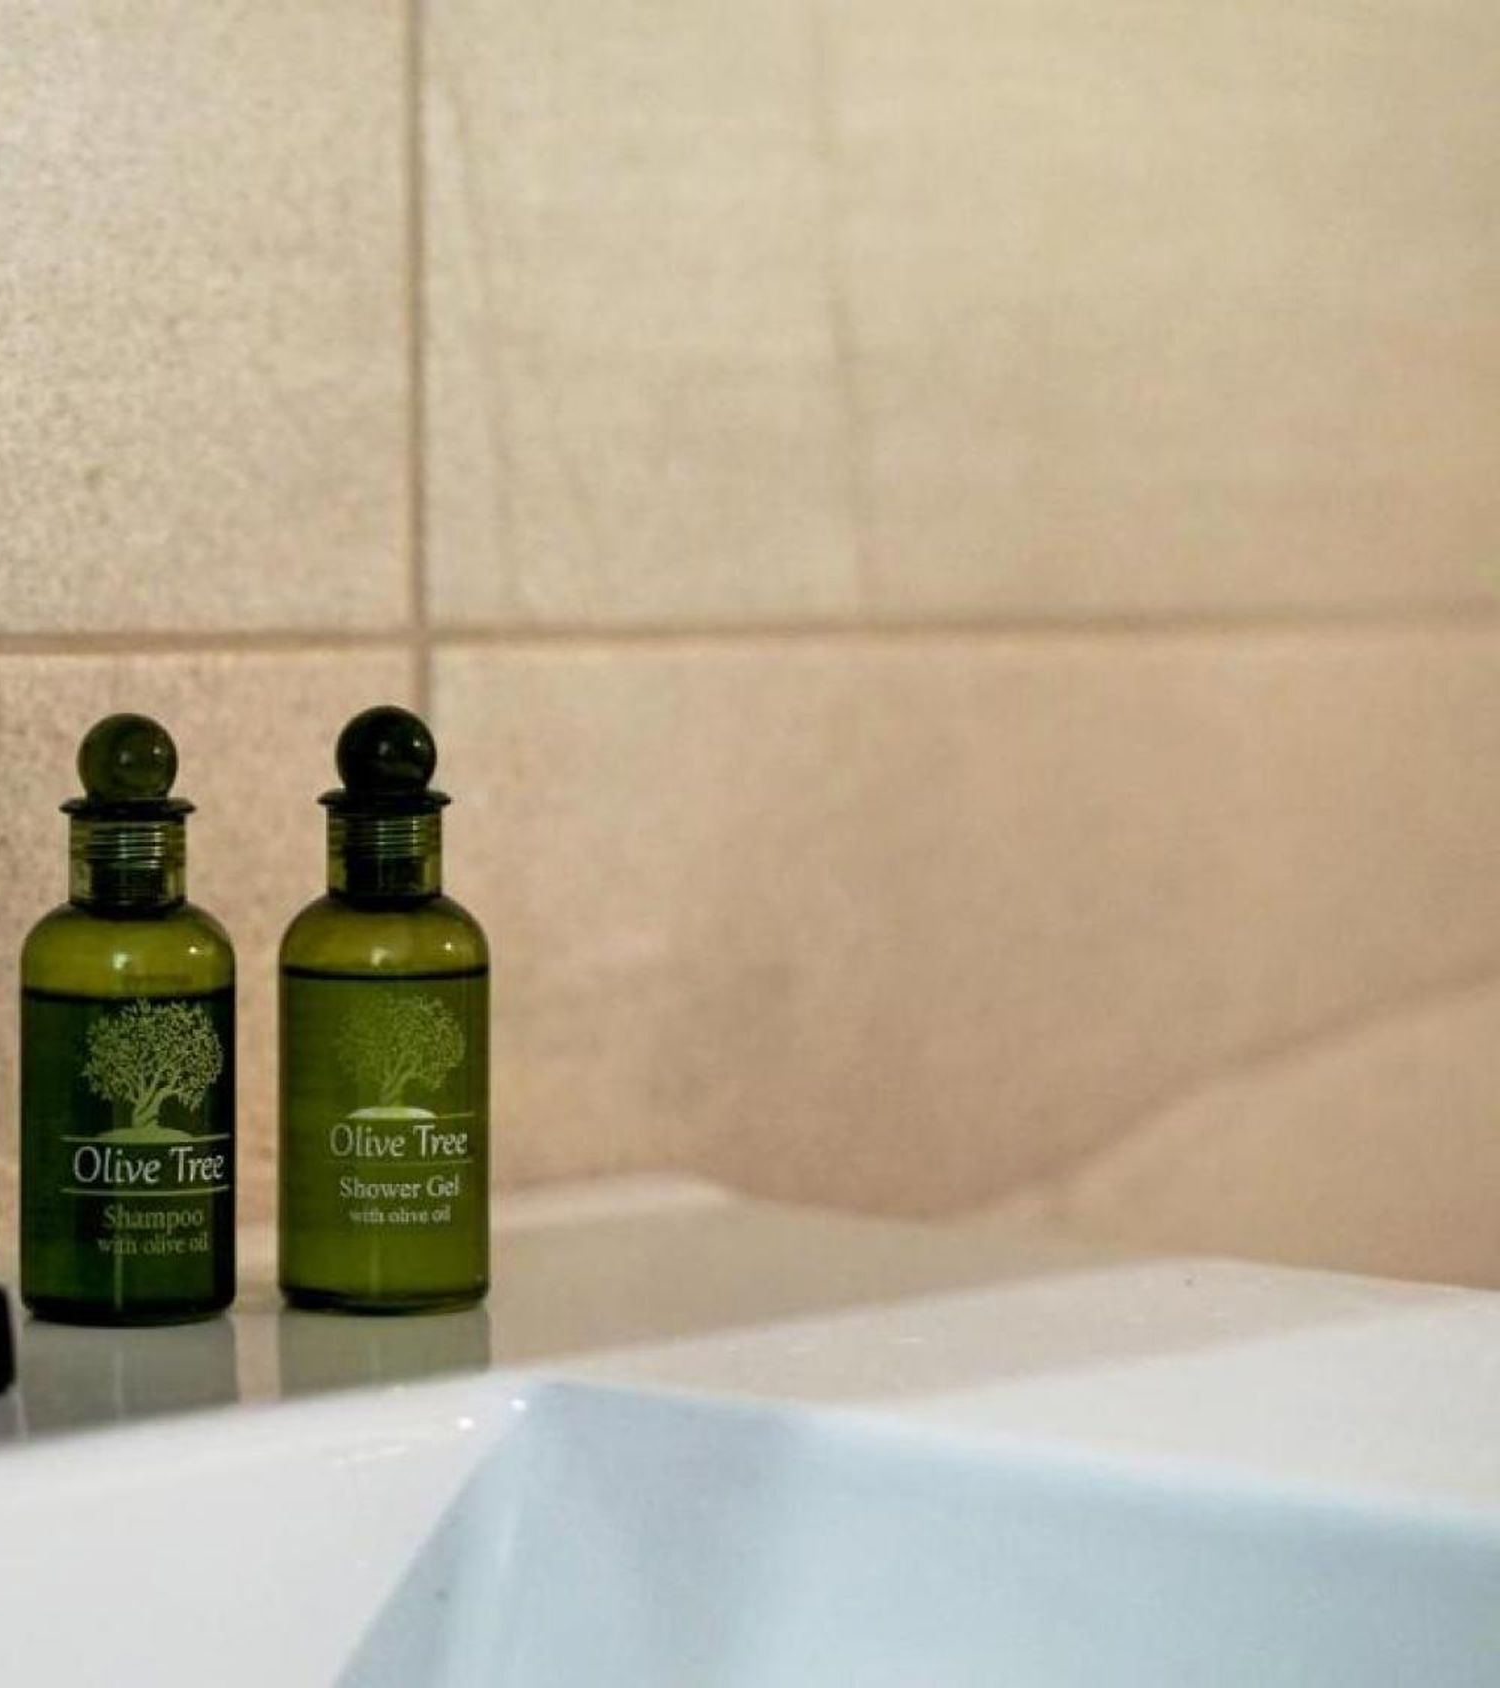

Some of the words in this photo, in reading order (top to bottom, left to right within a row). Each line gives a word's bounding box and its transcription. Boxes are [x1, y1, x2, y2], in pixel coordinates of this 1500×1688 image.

[330, 1123, 405, 1157] Olive
[412, 1123, 468, 1158] Tree
[74, 1146, 162, 1183] Olive
[169, 1146, 225, 1183] Tree
[338, 1175, 421, 1200] Shower
[426, 1174, 460, 1199] Gel
[103, 1204, 203, 1233] Shampoo
[350, 1206, 385, 1225] with
[388, 1204, 427, 1225] olive
[97, 1235, 139, 1256] with
[143, 1234, 185, 1255] olive
